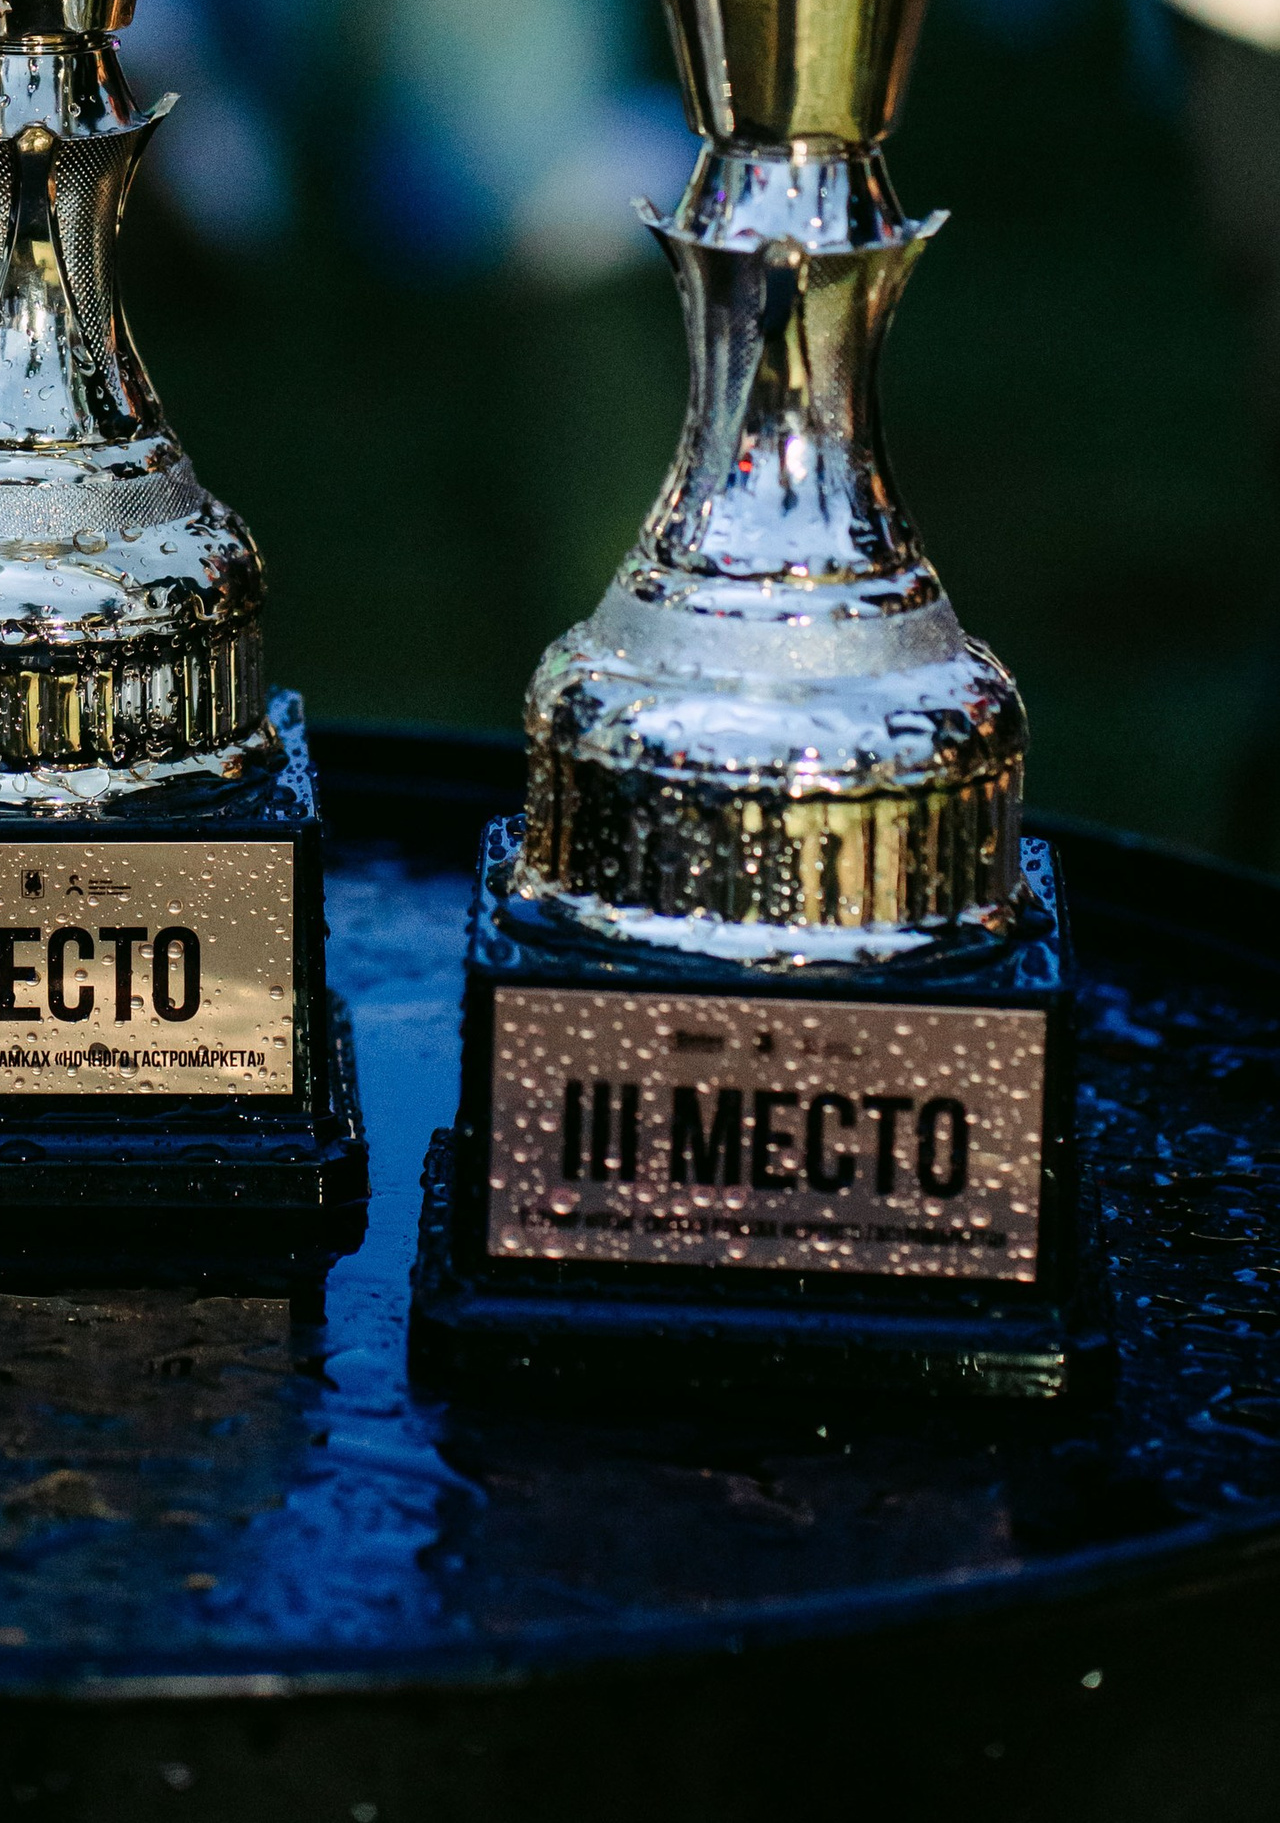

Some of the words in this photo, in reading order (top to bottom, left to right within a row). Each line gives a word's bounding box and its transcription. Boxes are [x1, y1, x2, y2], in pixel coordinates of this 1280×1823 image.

[54, 1050, 130, 1068] «НОЧНОГО
[133, 1050, 265, 1068] ГАСТРОМАРКЕТА»
[669, 1086, 968, 1198] МЕСТО
